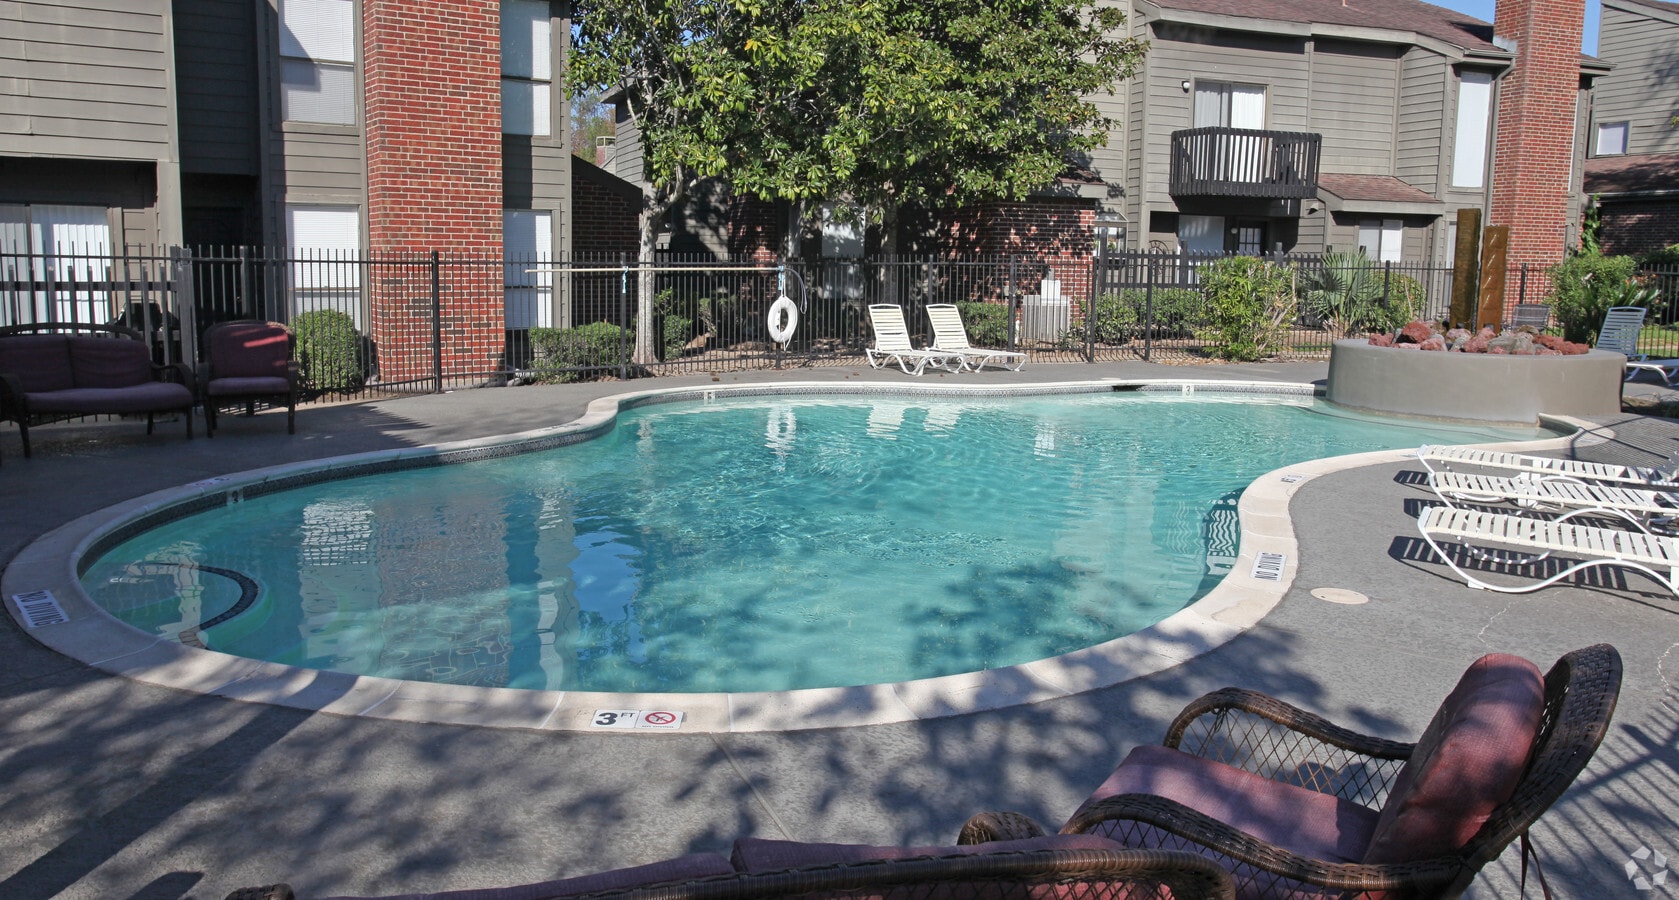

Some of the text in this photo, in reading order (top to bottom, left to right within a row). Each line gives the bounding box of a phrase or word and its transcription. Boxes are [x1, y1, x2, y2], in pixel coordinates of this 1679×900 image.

[1254, 552, 1283, 581] NO DIVING
[17, 590, 65, 626] NO DIVING
[595, 712, 618, 726] 3
